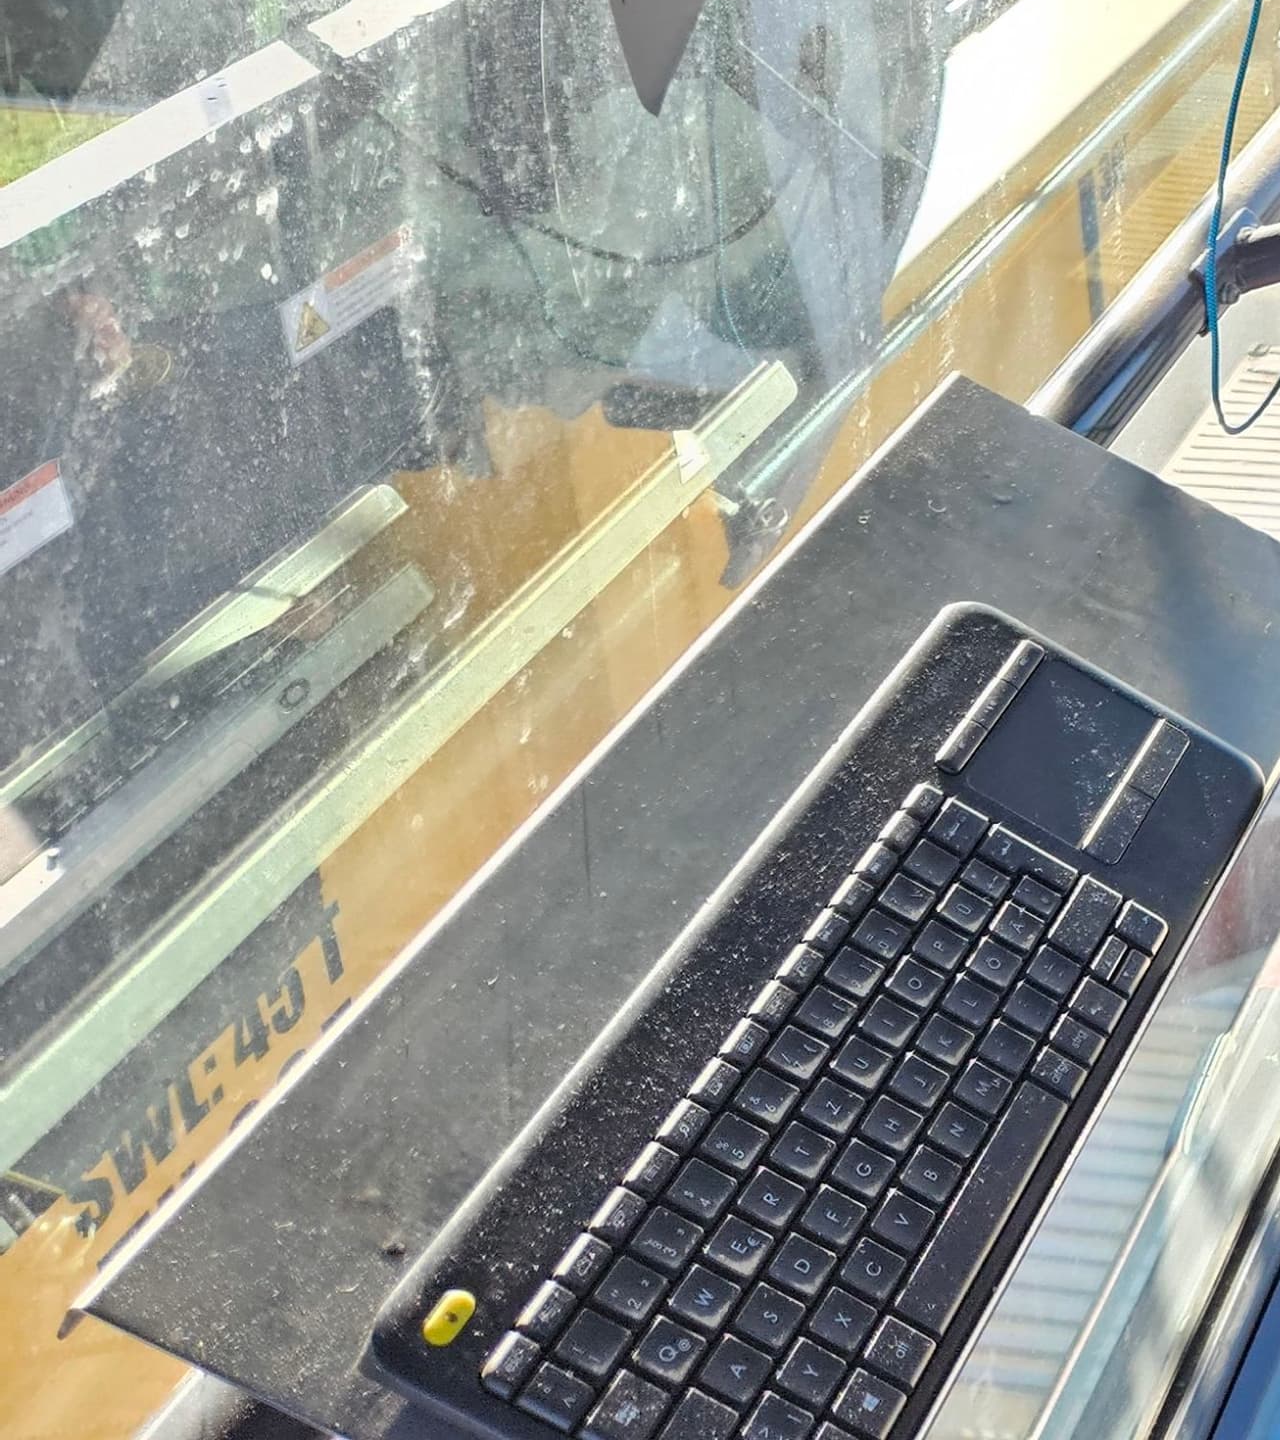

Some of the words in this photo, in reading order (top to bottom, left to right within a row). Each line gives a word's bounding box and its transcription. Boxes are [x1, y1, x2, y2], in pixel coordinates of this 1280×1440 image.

[827, 1099, 843, 1116] Z
[885, 1118, 901, 1133] H
[949, 1122, 966, 1137] N
[856, 1162, 872, 1177] G
[923, 1167, 939, 1182] B
[763, 1193, 780, 1207] R
[826, 1210, 841, 1224] F
[894, 1213, 910, 1228] V
[794, 1259, 810, 1275] D
[866, 1263, 882, 1277] C
[697, 1288, 717, 1307] W
[763, 1311, 780, 1324] S
[835, 1314, 852, 1328] X
[732, 1364, 748, 1380] A
[803, 1364, 820, 1379] Y
